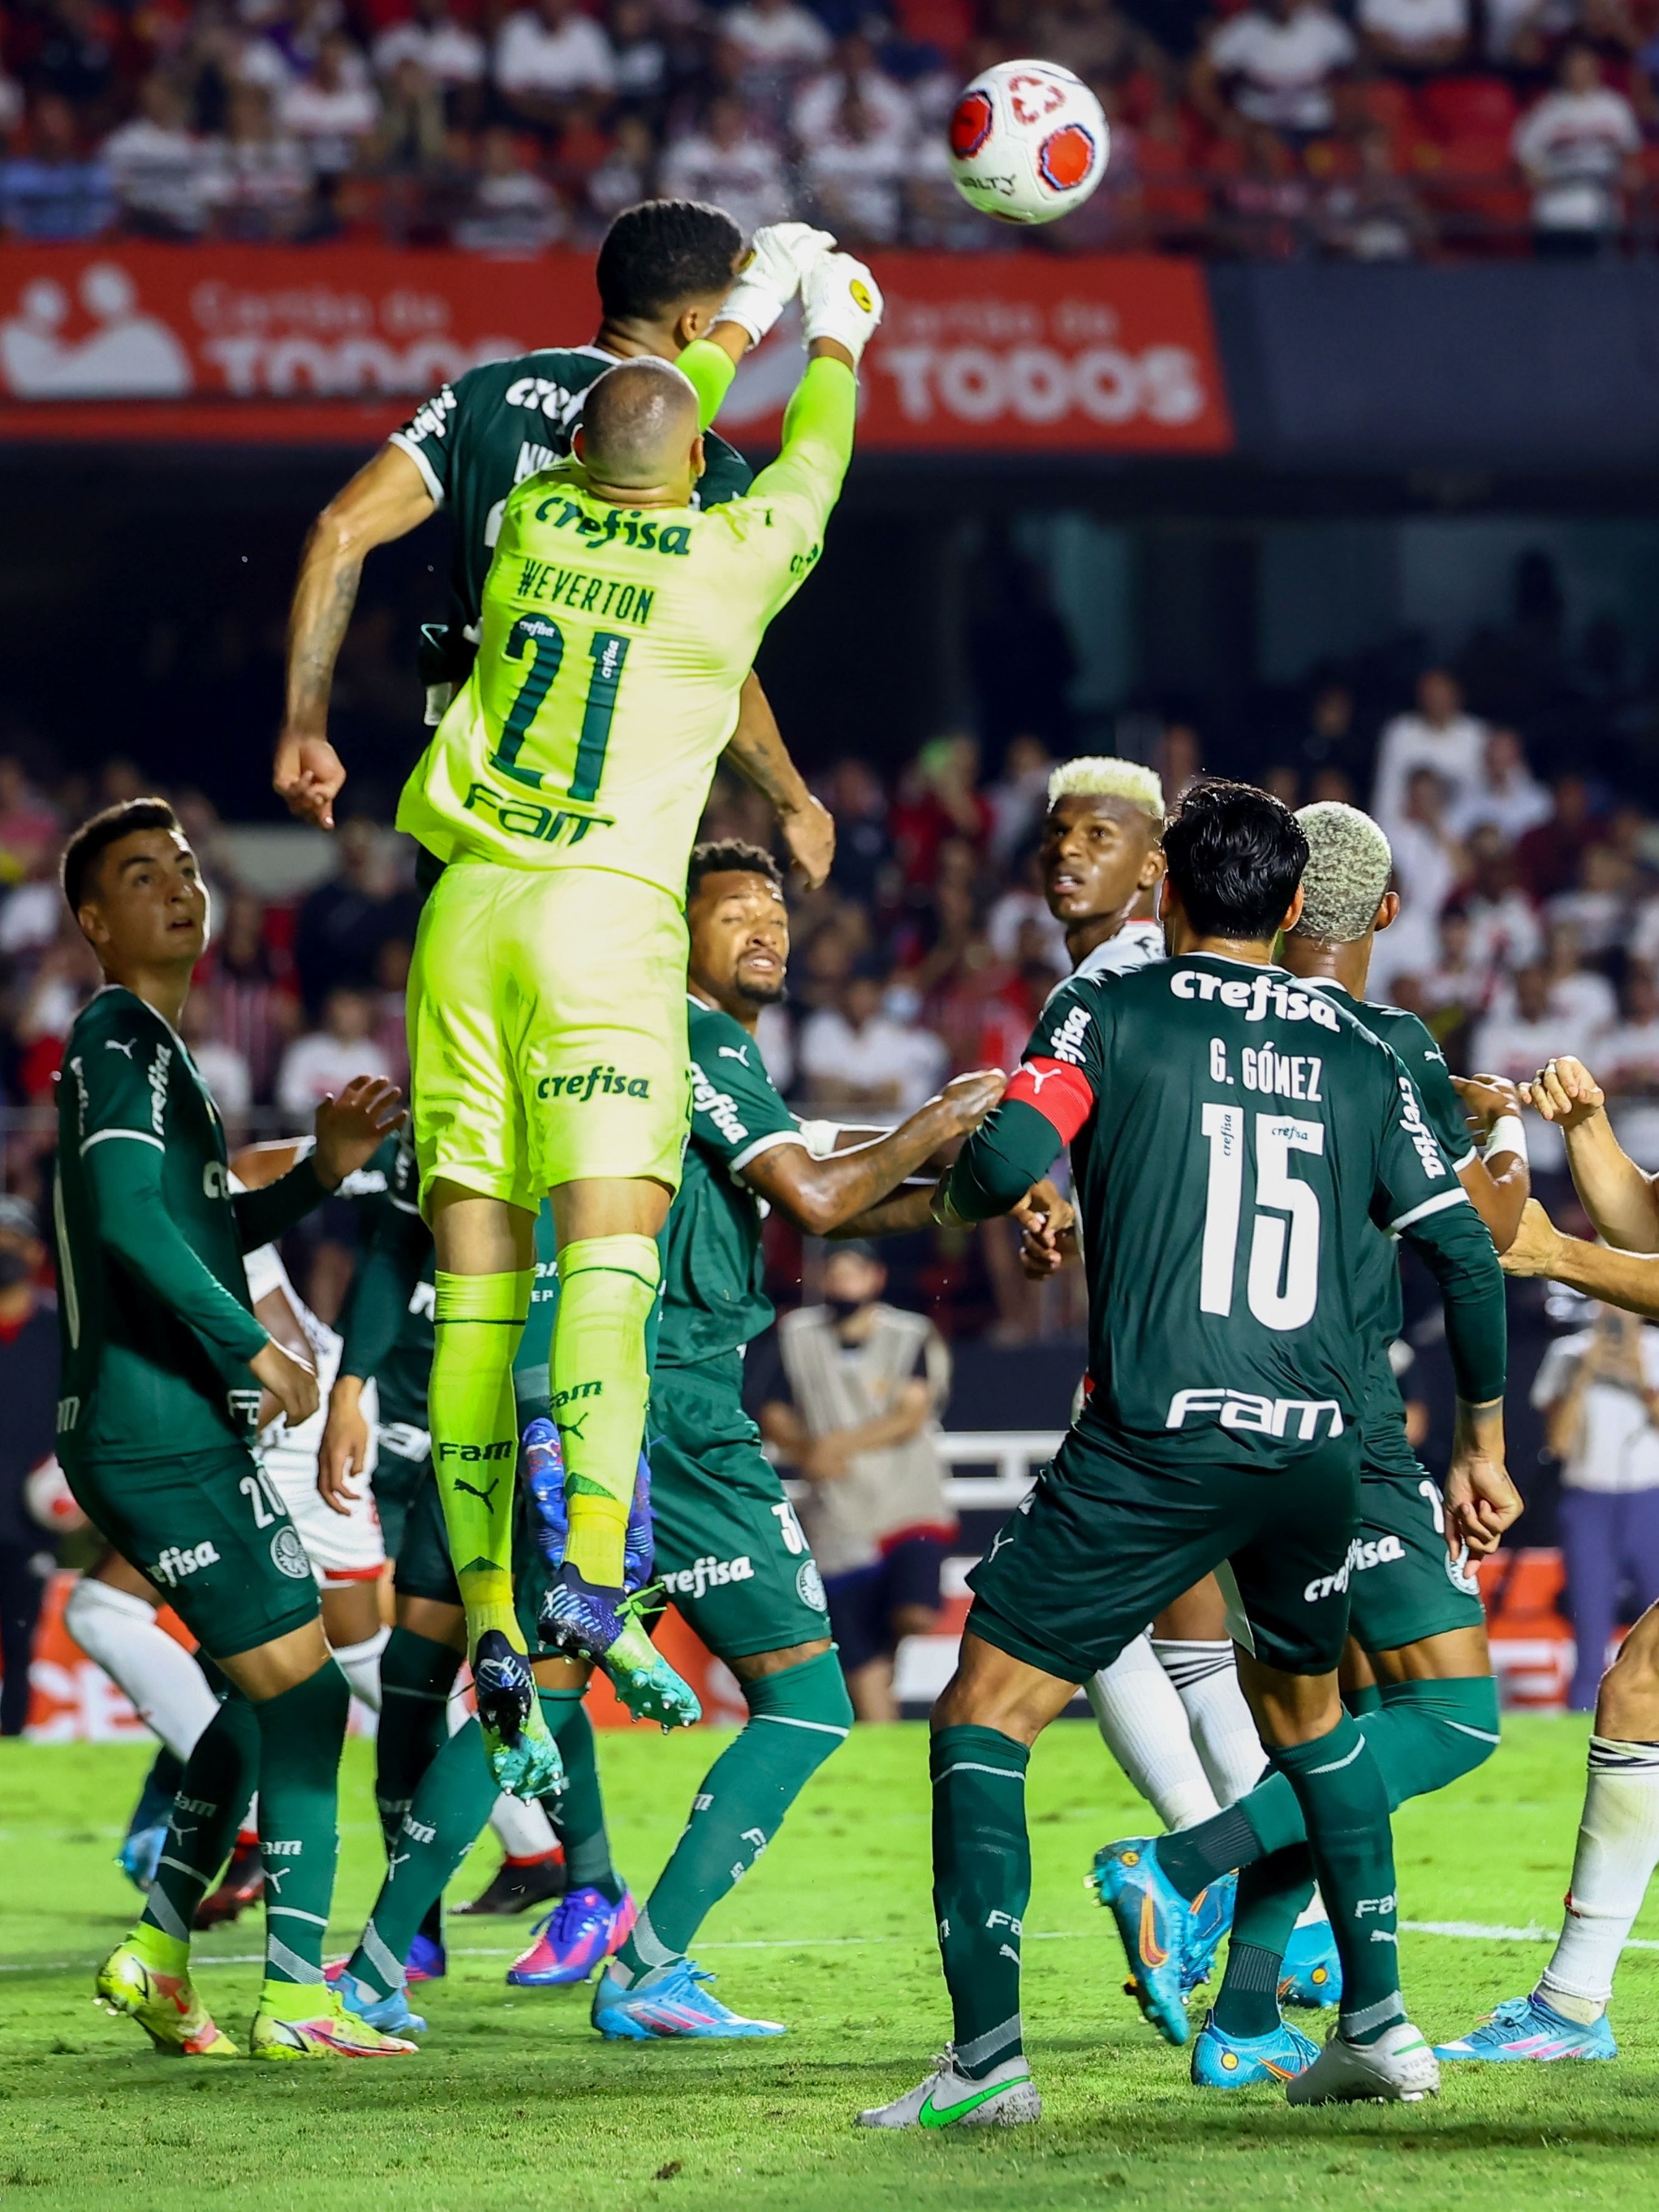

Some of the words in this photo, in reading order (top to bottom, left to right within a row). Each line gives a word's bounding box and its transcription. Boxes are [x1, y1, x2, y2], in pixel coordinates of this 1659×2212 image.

[878, 345, 1203, 426] TODOS
[535, 497, 692, 556] crefisa
[516, 558, 656, 626] WEVERTON
[519, 620, 555, 638] crefisa
[489, 613, 631, 803] 21
[1170, 970, 1340, 1031] crefisa
[537, 1065, 650, 1101] crefisa
[1209, 1038, 1233, 1085] G.
[1242, 1042, 1322, 1102] GÓMEZ
[1223, 1114, 1235, 1156] crefisa
[1398, 1076, 1446, 1179] crefisa
[1200, 1103, 1324, 1331] 15
[531, 1289, 554, 1302] EP
[239, 1467, 287, 1529] 20
